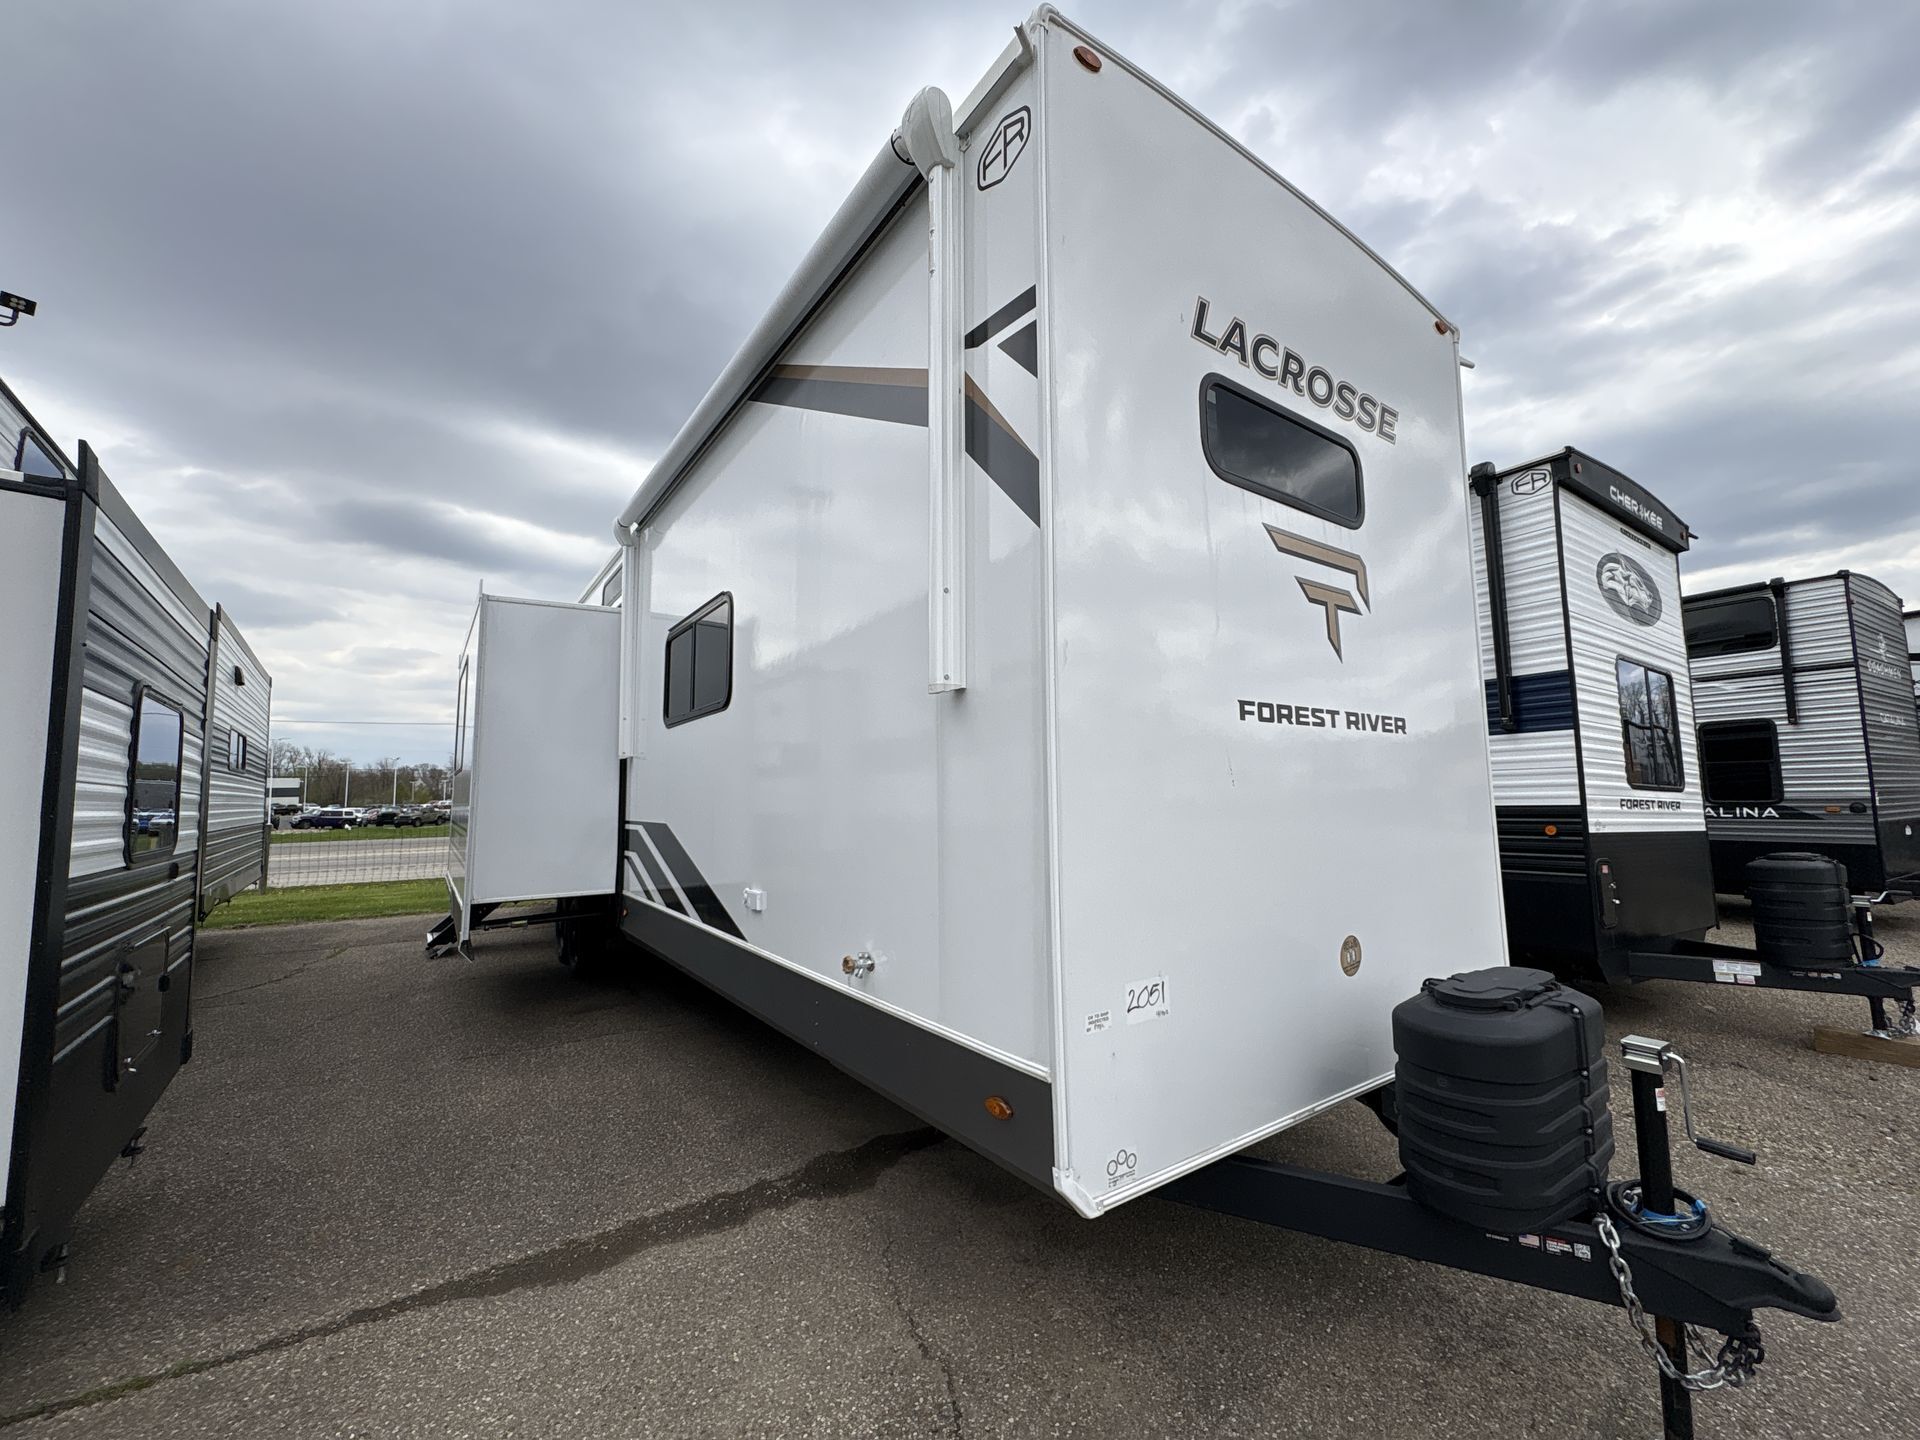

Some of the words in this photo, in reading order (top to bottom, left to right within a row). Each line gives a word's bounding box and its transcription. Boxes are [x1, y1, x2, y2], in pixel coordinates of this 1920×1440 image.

[1191, 296, 1399, 445] LACROSSE
[1237, 699, 1340, 729] FOREST
[1344, 711, 1407, 734] RIVER
[1620, 798, 1656, 810] FOREST
[1657, 800, 1681, 811] RIVER
[1126, 980, 1165, 1014] 2051
